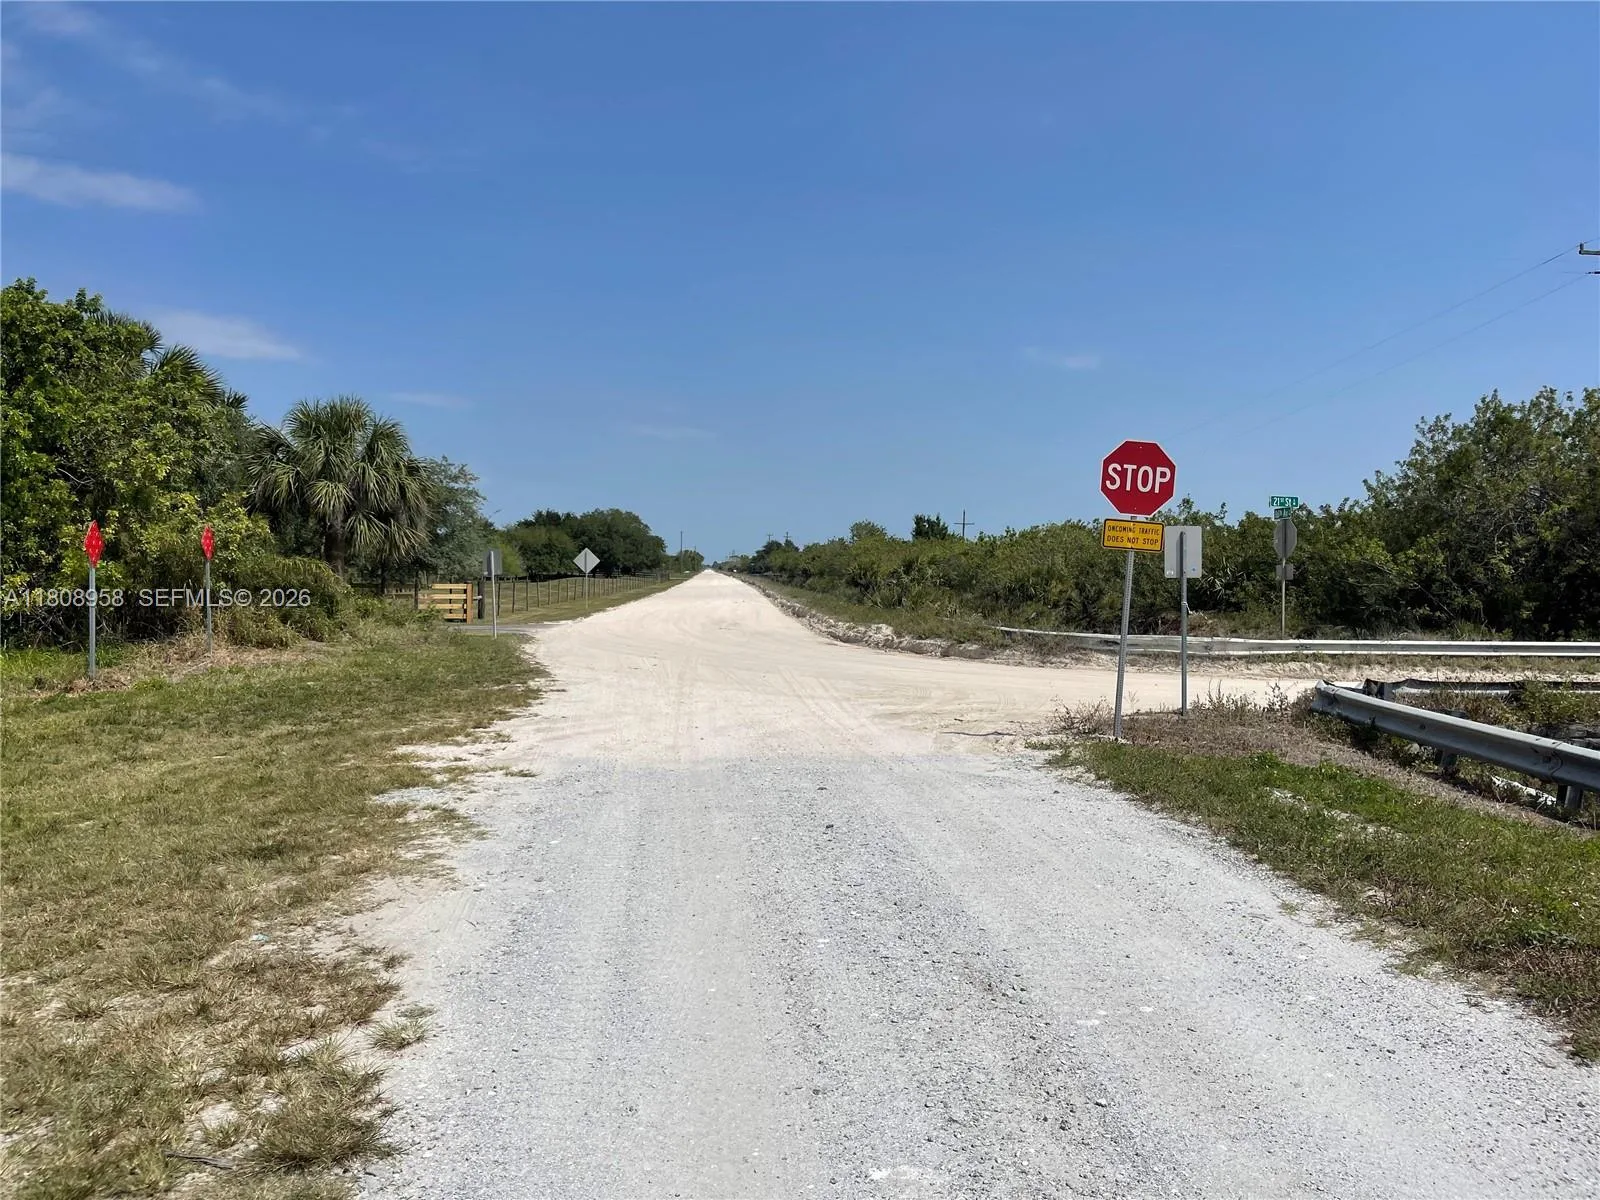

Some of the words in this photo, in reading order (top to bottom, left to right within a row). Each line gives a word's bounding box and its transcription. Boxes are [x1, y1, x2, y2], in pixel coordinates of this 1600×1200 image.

[1105, 463, 1171, 494] STOP
[1107, 525, 1136, 533] ONCOMING
[1138, 527, 1160, 536] TRAFFIC
[1106, 535, 1124, 543] DOES
[1127, 536, 1139, 544] NOT
[1142, 538, 1159, 546] STOP
